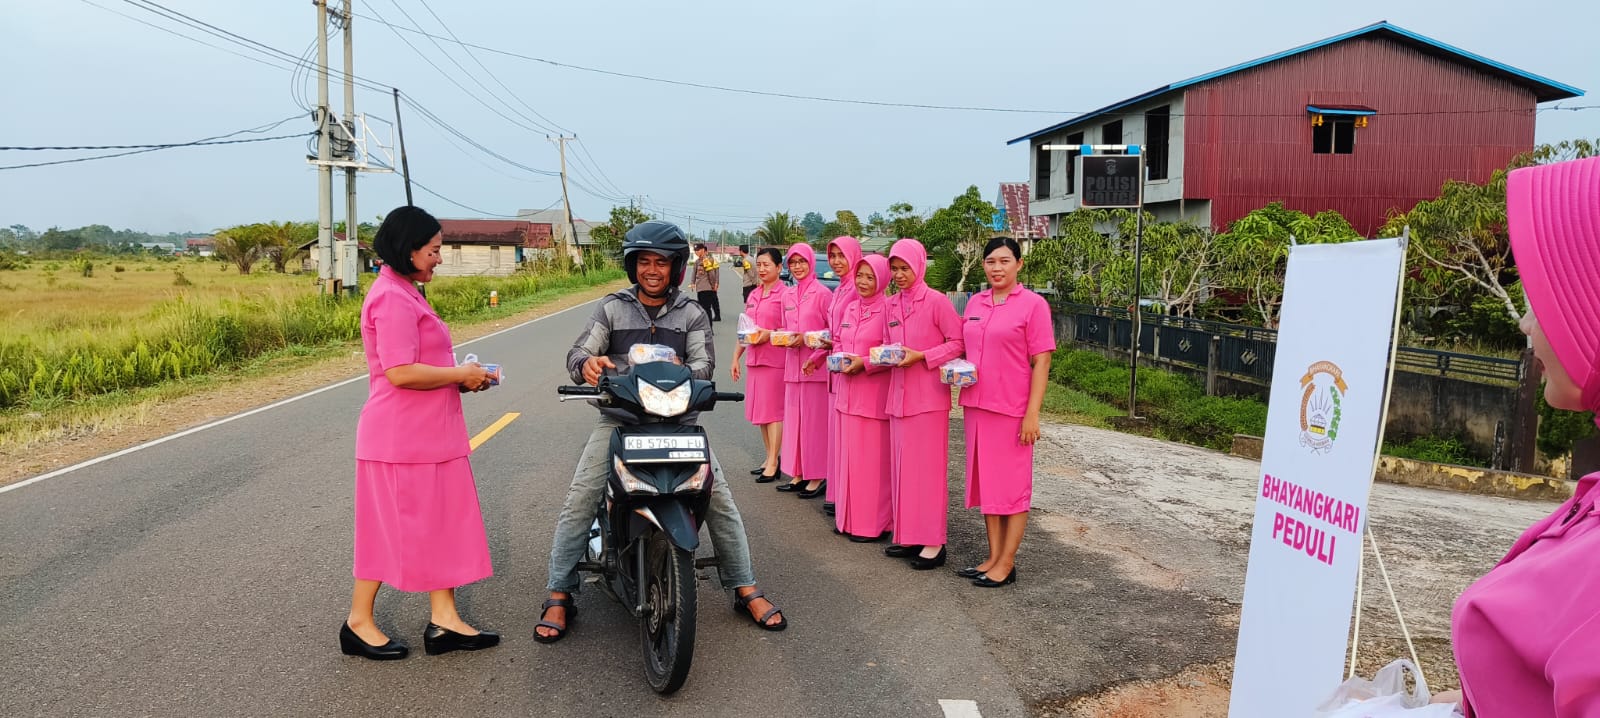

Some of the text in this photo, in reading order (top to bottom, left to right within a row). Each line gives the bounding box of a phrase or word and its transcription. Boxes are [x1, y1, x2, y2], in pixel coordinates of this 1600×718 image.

[1086, 176, 1136, 190] POLISI
[1086, 191, 1136, 204] POLICE
[627, 438, 643, 449] KB
[648, 438, 678, 449] 5750
[1262, 473, 1360, 534] BHAYANGKARI
[1272, 511, 1336, 566] PEDULI
